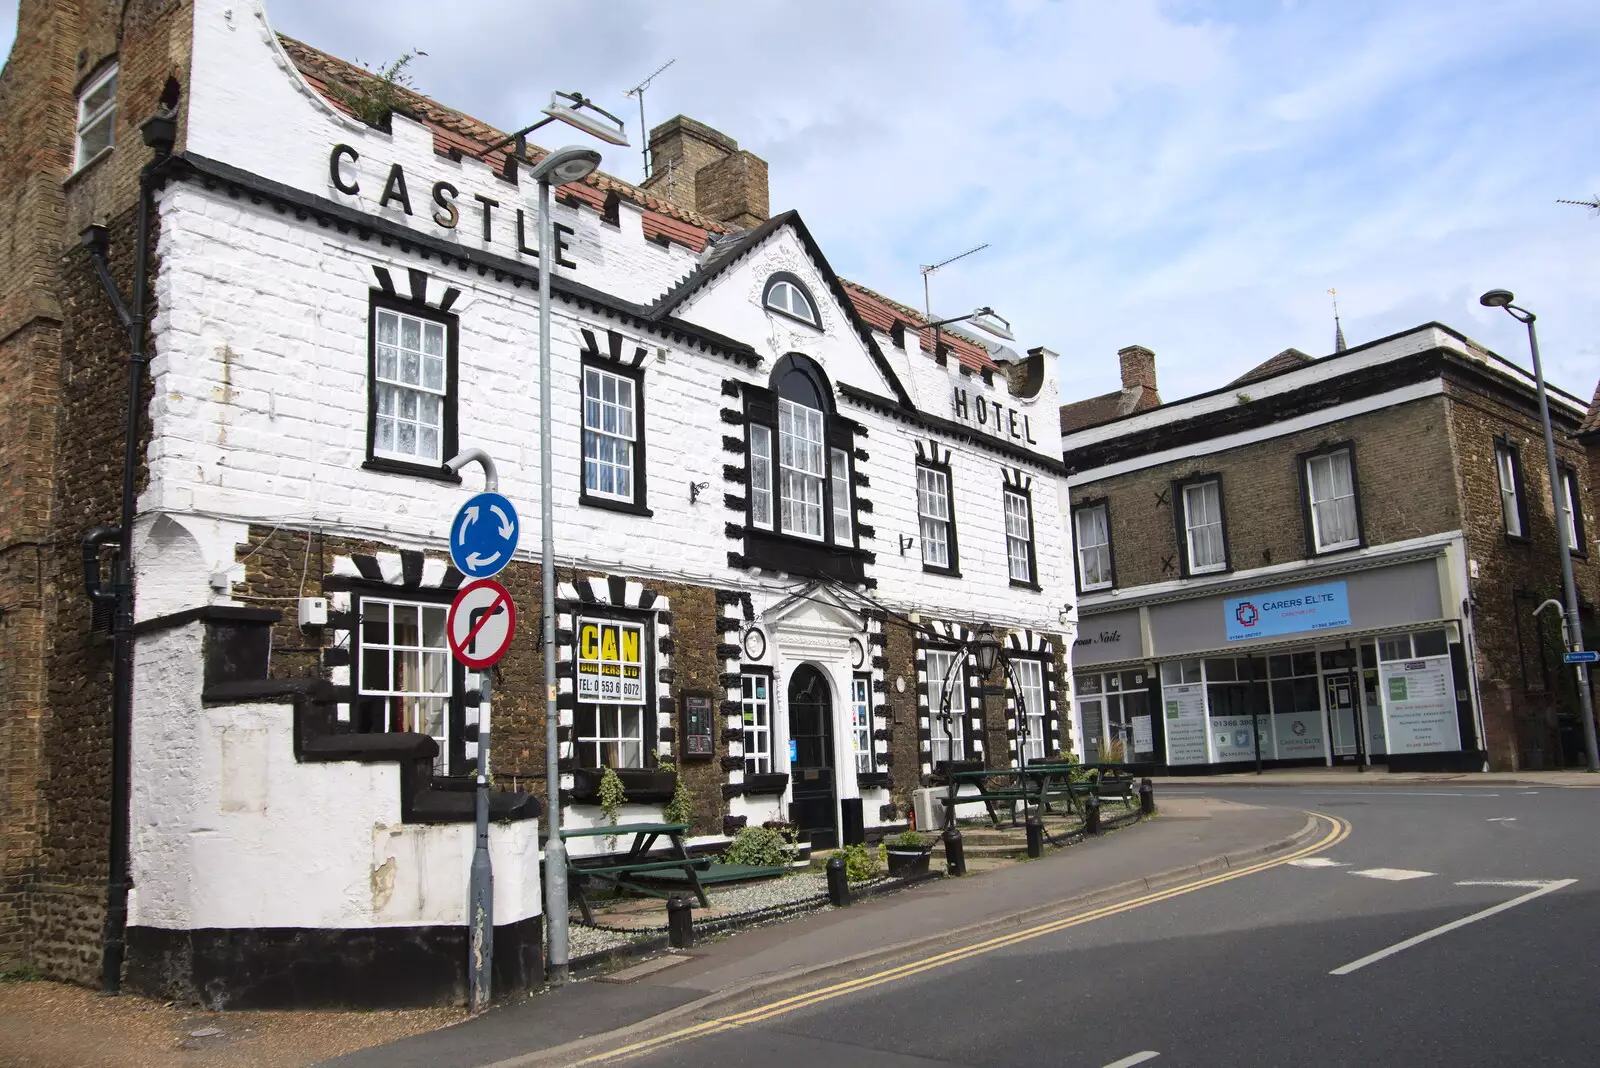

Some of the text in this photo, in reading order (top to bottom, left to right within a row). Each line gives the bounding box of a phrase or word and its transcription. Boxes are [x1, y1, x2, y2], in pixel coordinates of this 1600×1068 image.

[329, 143, 577, 270] CASTLE
[954, 386, 1036, 445] HOTEL
[1262, 598, 1303, 611] CARERS
[581, 624, 638, 663] CAN
[1094, 630, 1121, 645] Nailz
[623, 666, 638, 677] LTD
[1213, 719, 1238, 727] 01366
